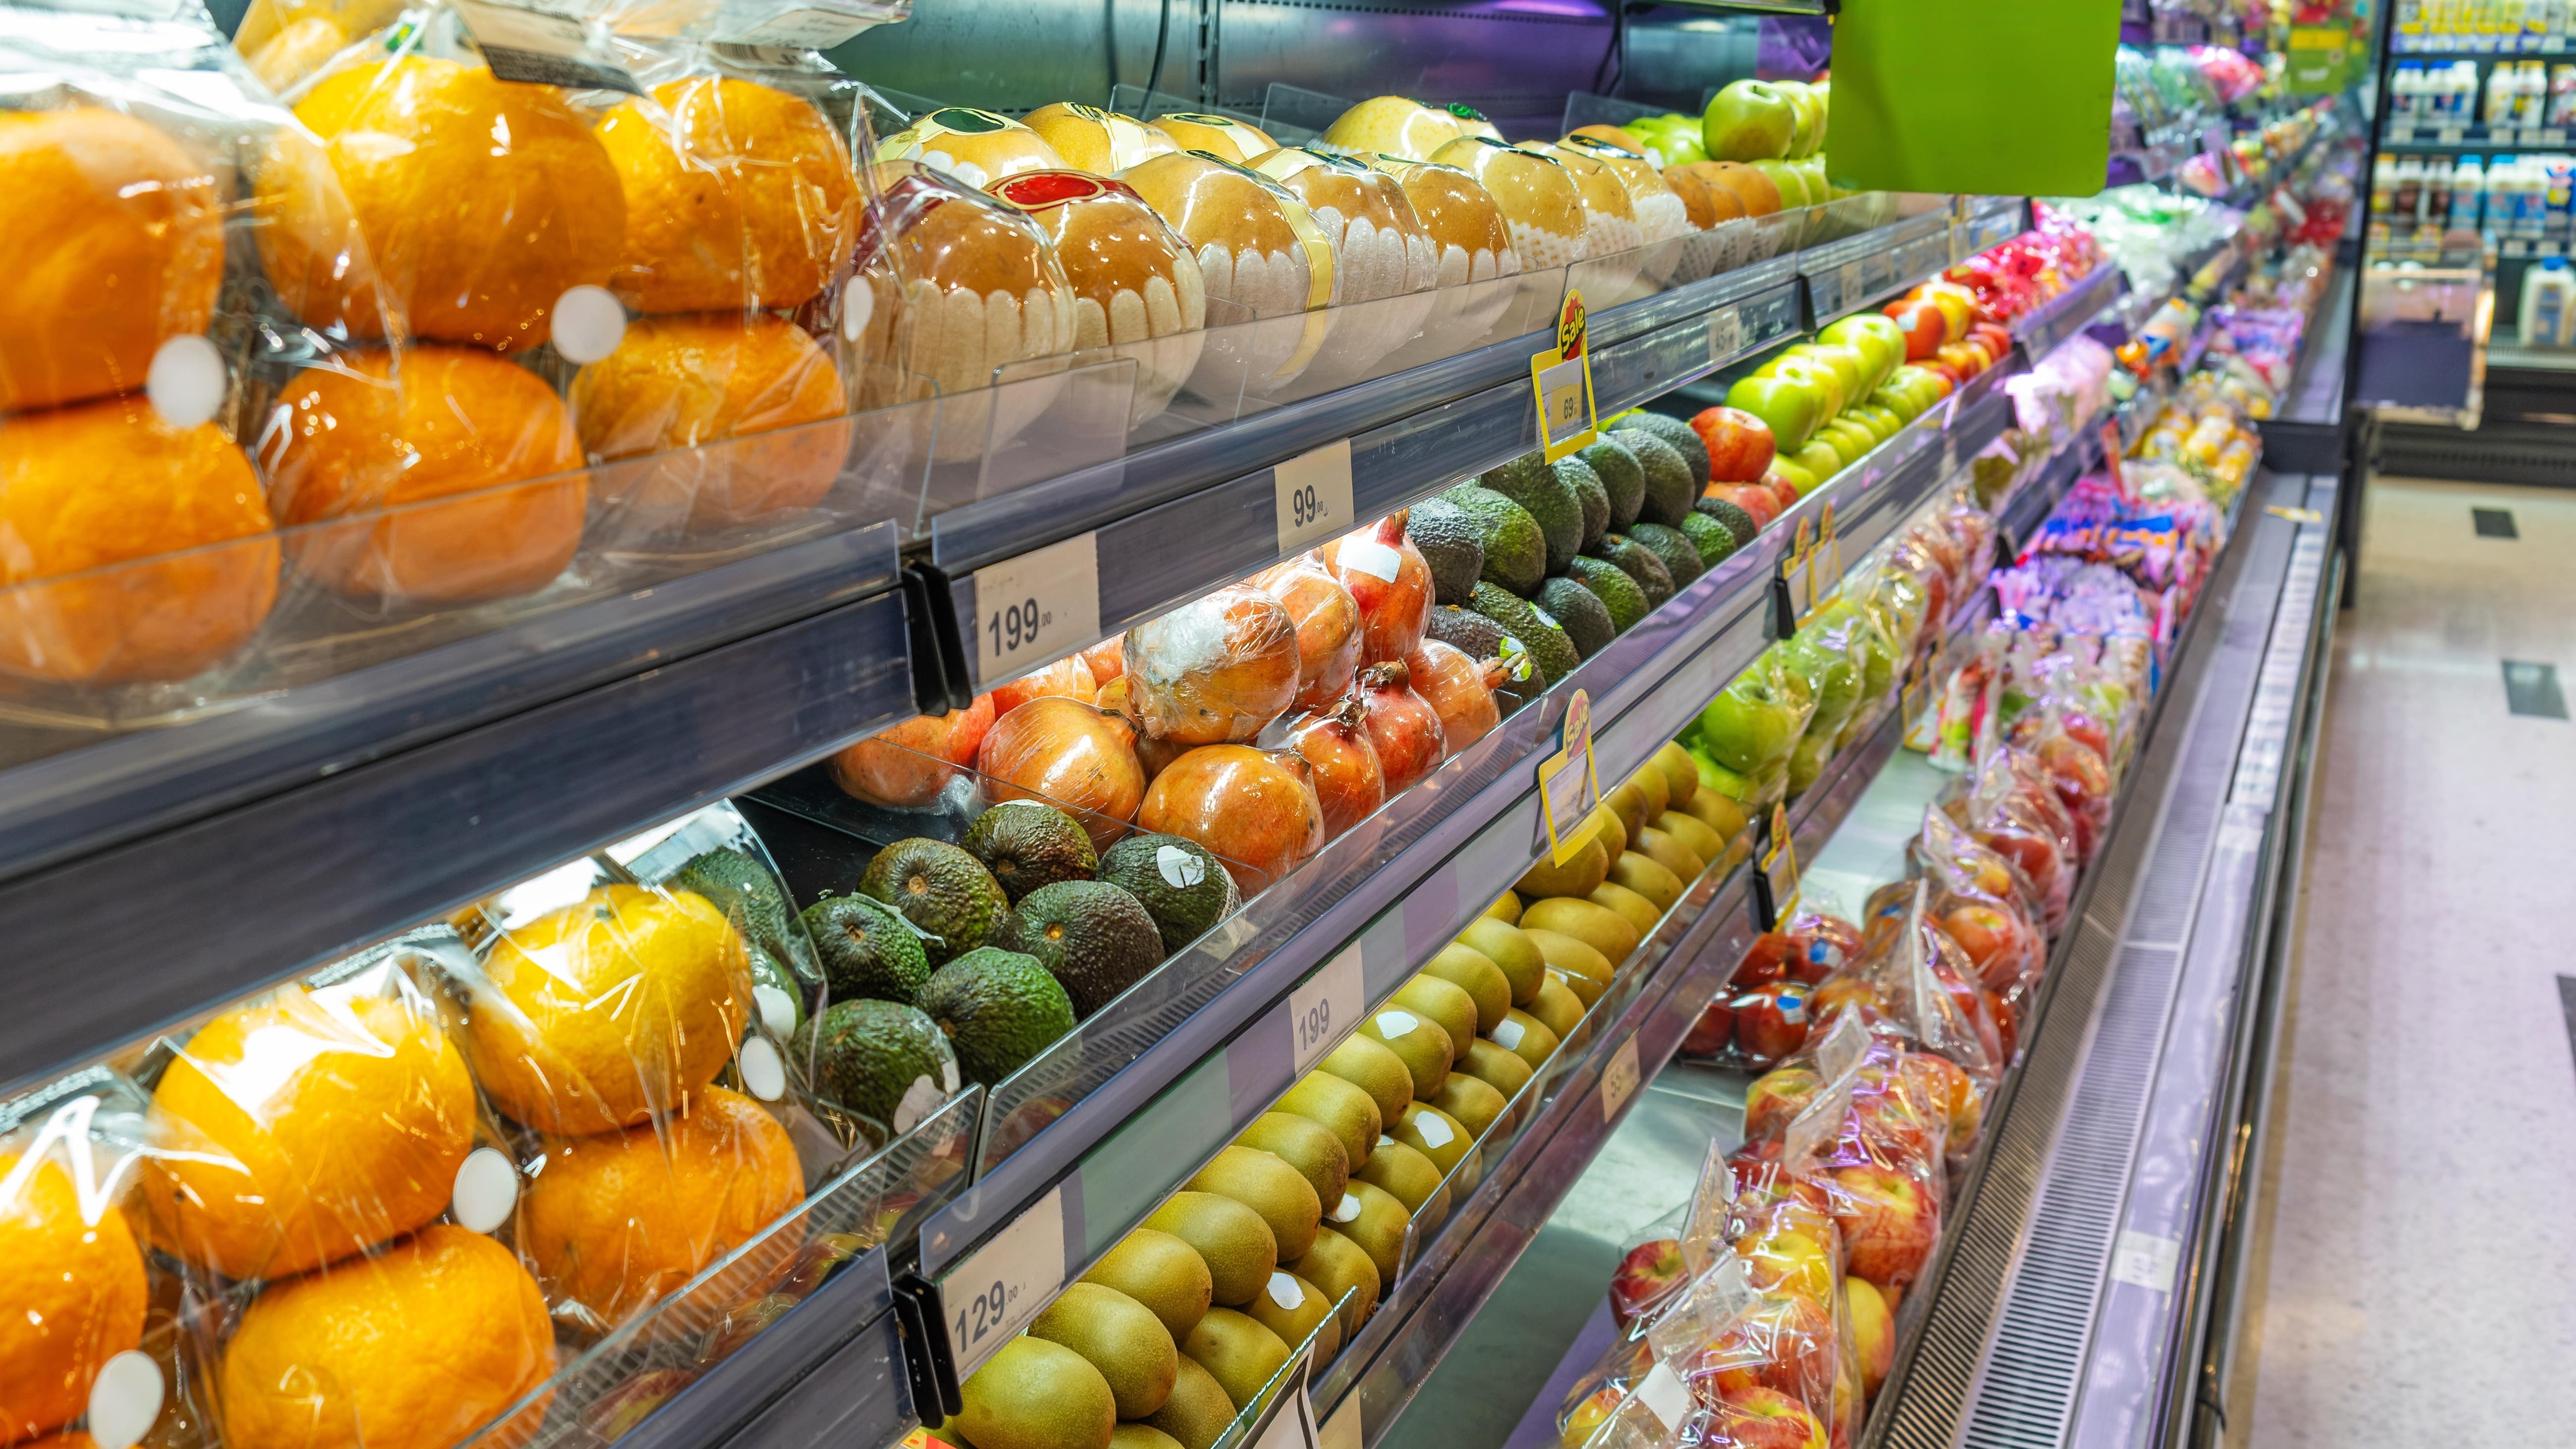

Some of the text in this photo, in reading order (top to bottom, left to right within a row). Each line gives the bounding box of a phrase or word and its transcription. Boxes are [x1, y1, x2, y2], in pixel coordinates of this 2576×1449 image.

[1562, 306, 1584, 353] Sale
[1564, 397, 1573, 419] 69
[1566, 701, 1589, 752] Sale
[1299, 998, 1330, 1051] 199
